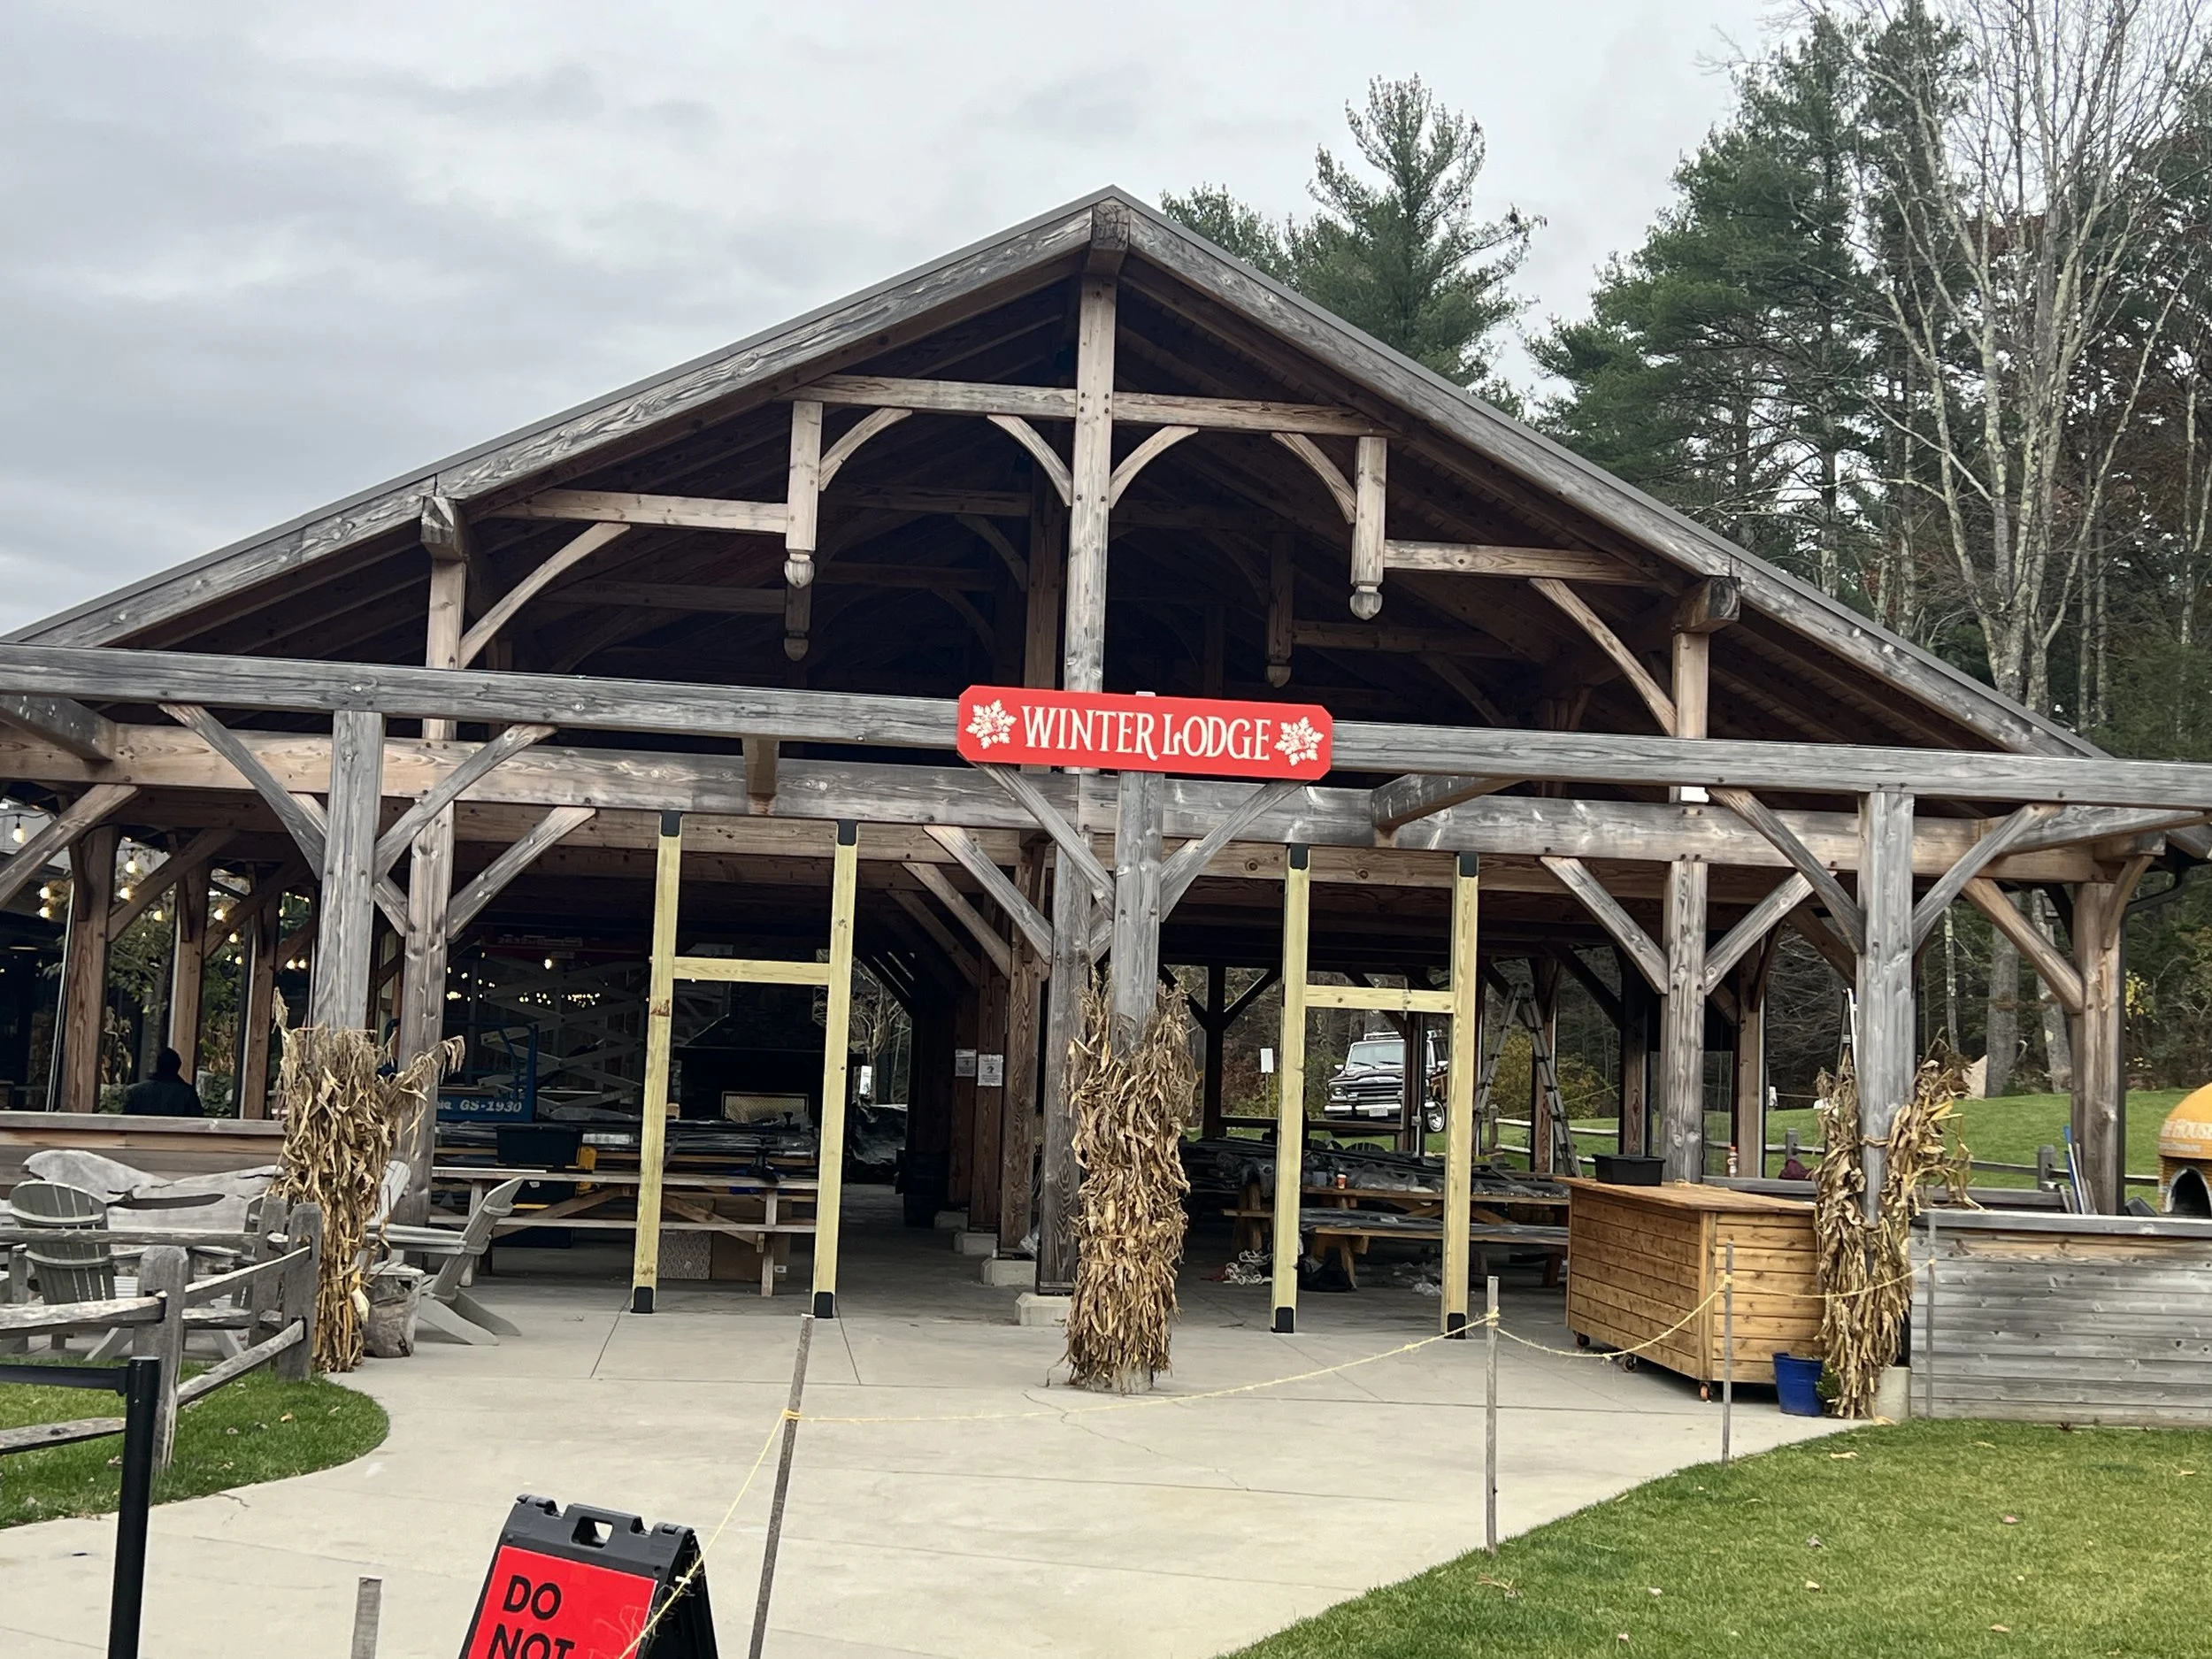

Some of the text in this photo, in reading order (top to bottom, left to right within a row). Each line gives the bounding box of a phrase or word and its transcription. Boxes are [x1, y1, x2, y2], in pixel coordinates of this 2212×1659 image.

[1020, 704, 1272, 762] WINTER LODGE
[459, 1099, 522, 1113] GS-1930
[502, 1574, 563, 1620] DO
[488, 1623, 576, 1659] NOT
